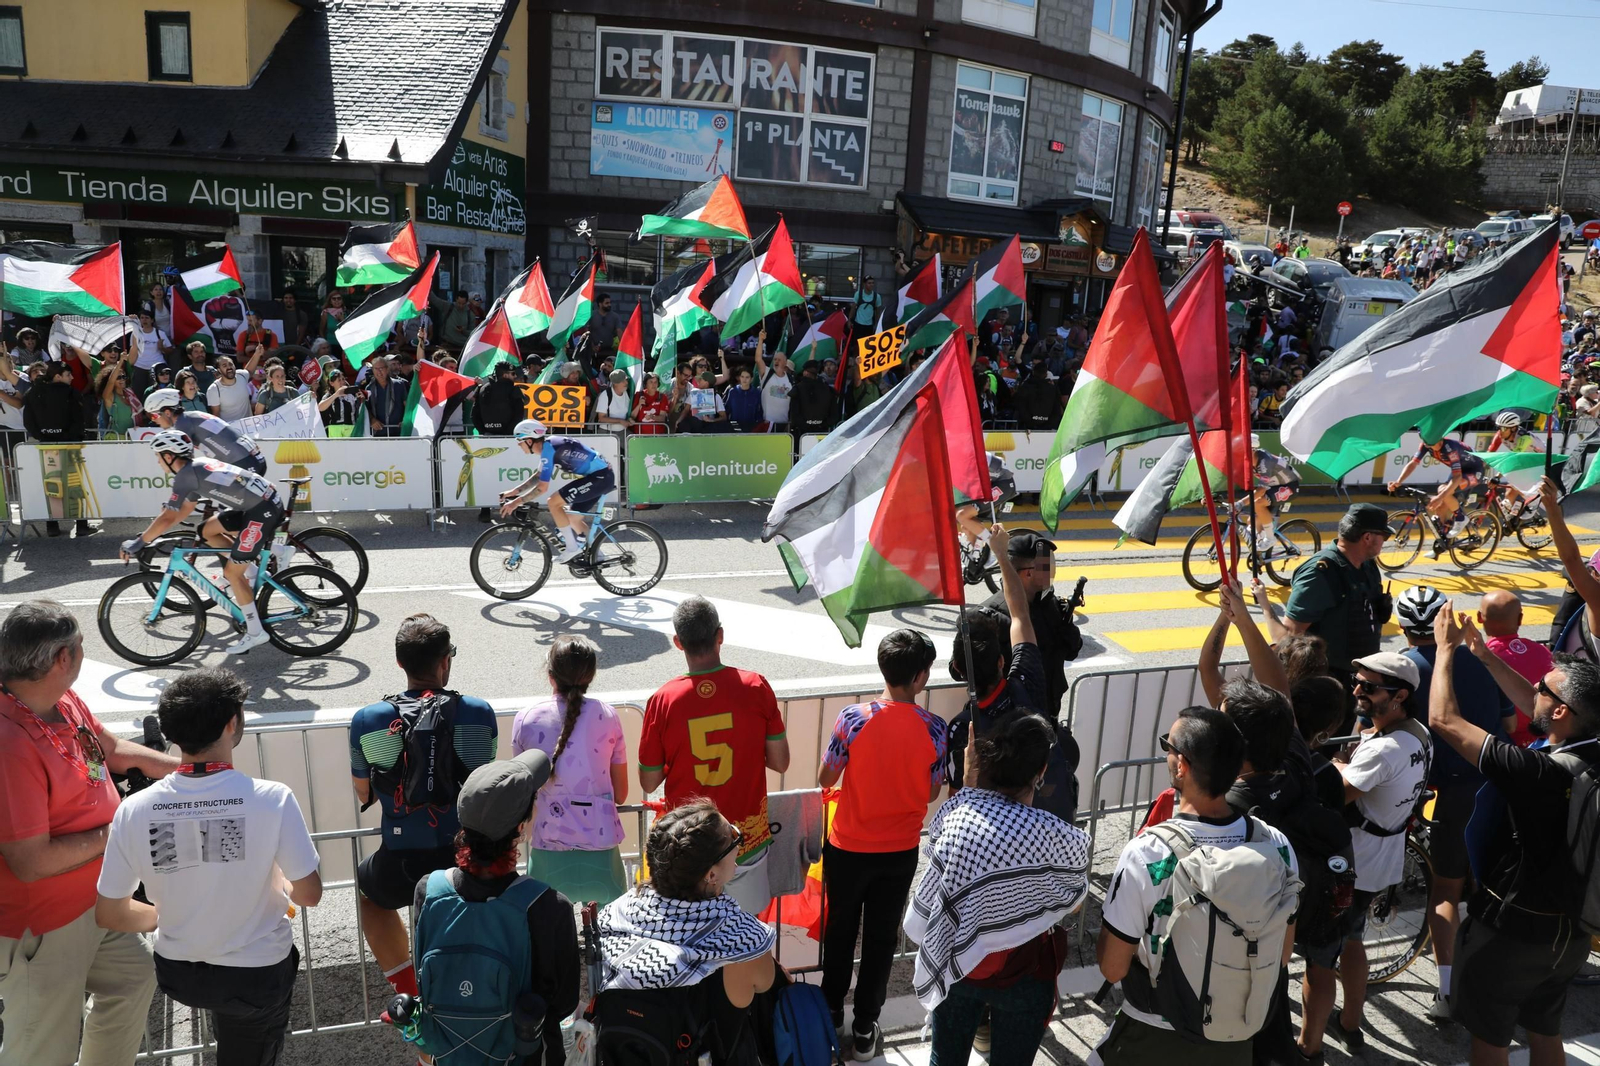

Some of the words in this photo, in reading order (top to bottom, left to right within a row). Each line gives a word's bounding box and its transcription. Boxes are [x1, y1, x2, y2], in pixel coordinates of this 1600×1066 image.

[605, 46, 866, 101] RESTAURANTE
[626, 106, 699, 130] ALQUILER
[767, 123, 861, 153] PLANTA
[626, 138, 667, 160] SNOWBOARD
[675, 151, 704, 166] TRINEOS
[0, 170, 32, 195] rd
[58, 171, 167, 203] Tienda
[188, 179, 313, 213] Alquiler
[322, 186, 390, 216] Skis
[443, 168, 489, 200] Alquiler
[427, 195, 452, 222] Bar
[863, 348, 903, 373] sierr
[523, 407, 581, 423] ierra
[561, 449, 589, 460] FACTOR
[323, 465, 406, 489] energía
[688, 460, 778, 480] plenitude
[428, 735, 437, 774] Kalenji
[687, 712, 734, 787] 5
[152, 801, 192, 811] CONCRETE
[193, 797, 244, 809] STRUCTURES
